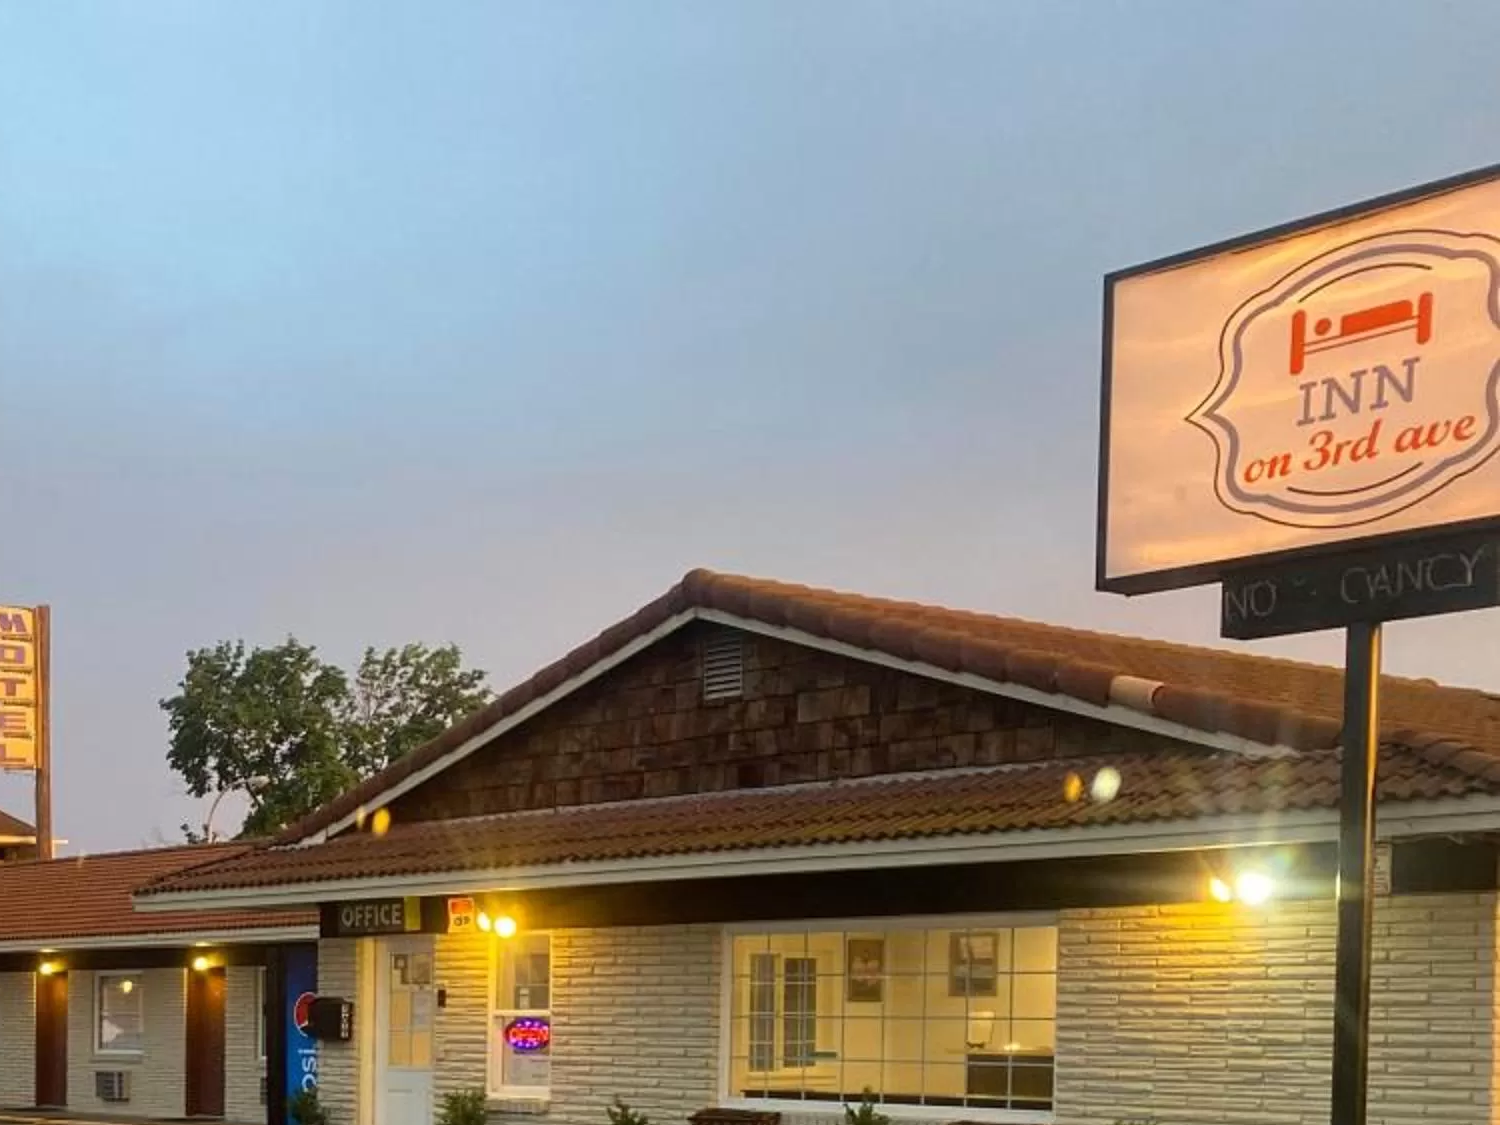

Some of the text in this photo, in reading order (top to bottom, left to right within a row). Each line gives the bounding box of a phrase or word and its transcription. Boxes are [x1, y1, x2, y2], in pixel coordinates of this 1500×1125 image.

[1296, 356, 1421, 427] INN
[1243, 414, 1477, 484] on 3rd ave
[1224, 579, 1278, 625] NO
[340, 903, 401, 928] OFFICE
